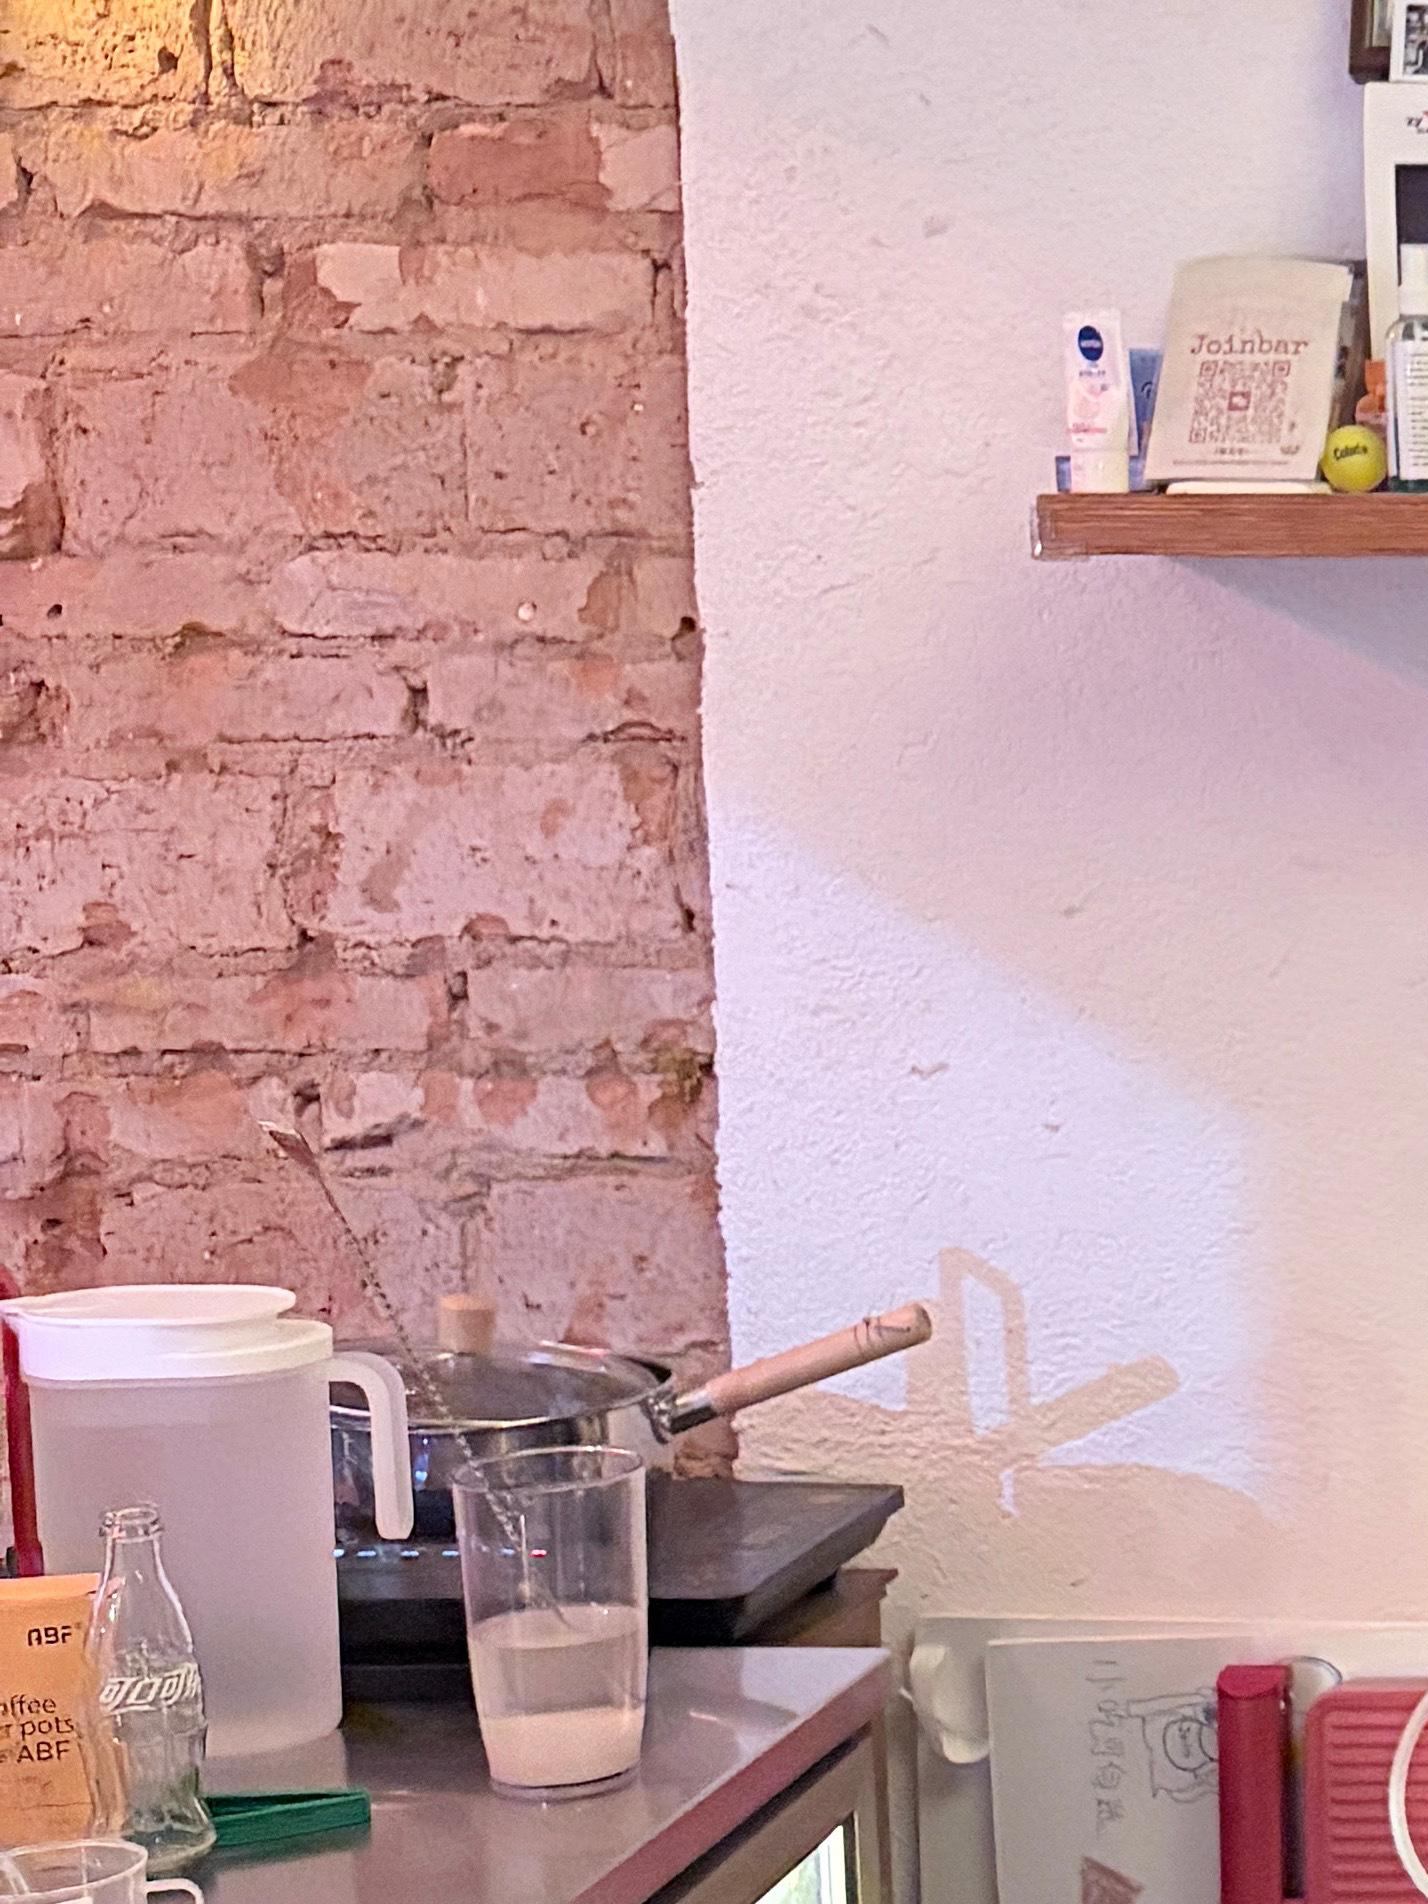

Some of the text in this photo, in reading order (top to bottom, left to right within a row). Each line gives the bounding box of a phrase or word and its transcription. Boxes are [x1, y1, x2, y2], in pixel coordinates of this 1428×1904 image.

[1190, 328, 1309, 357] Joinbar
[27, 1625, 73, 1647] ABF
[0, 1693, 57, 1717] offee
[19, 1716, 75, 1742] pots
[16, 1739, 71, 1764] ABF
